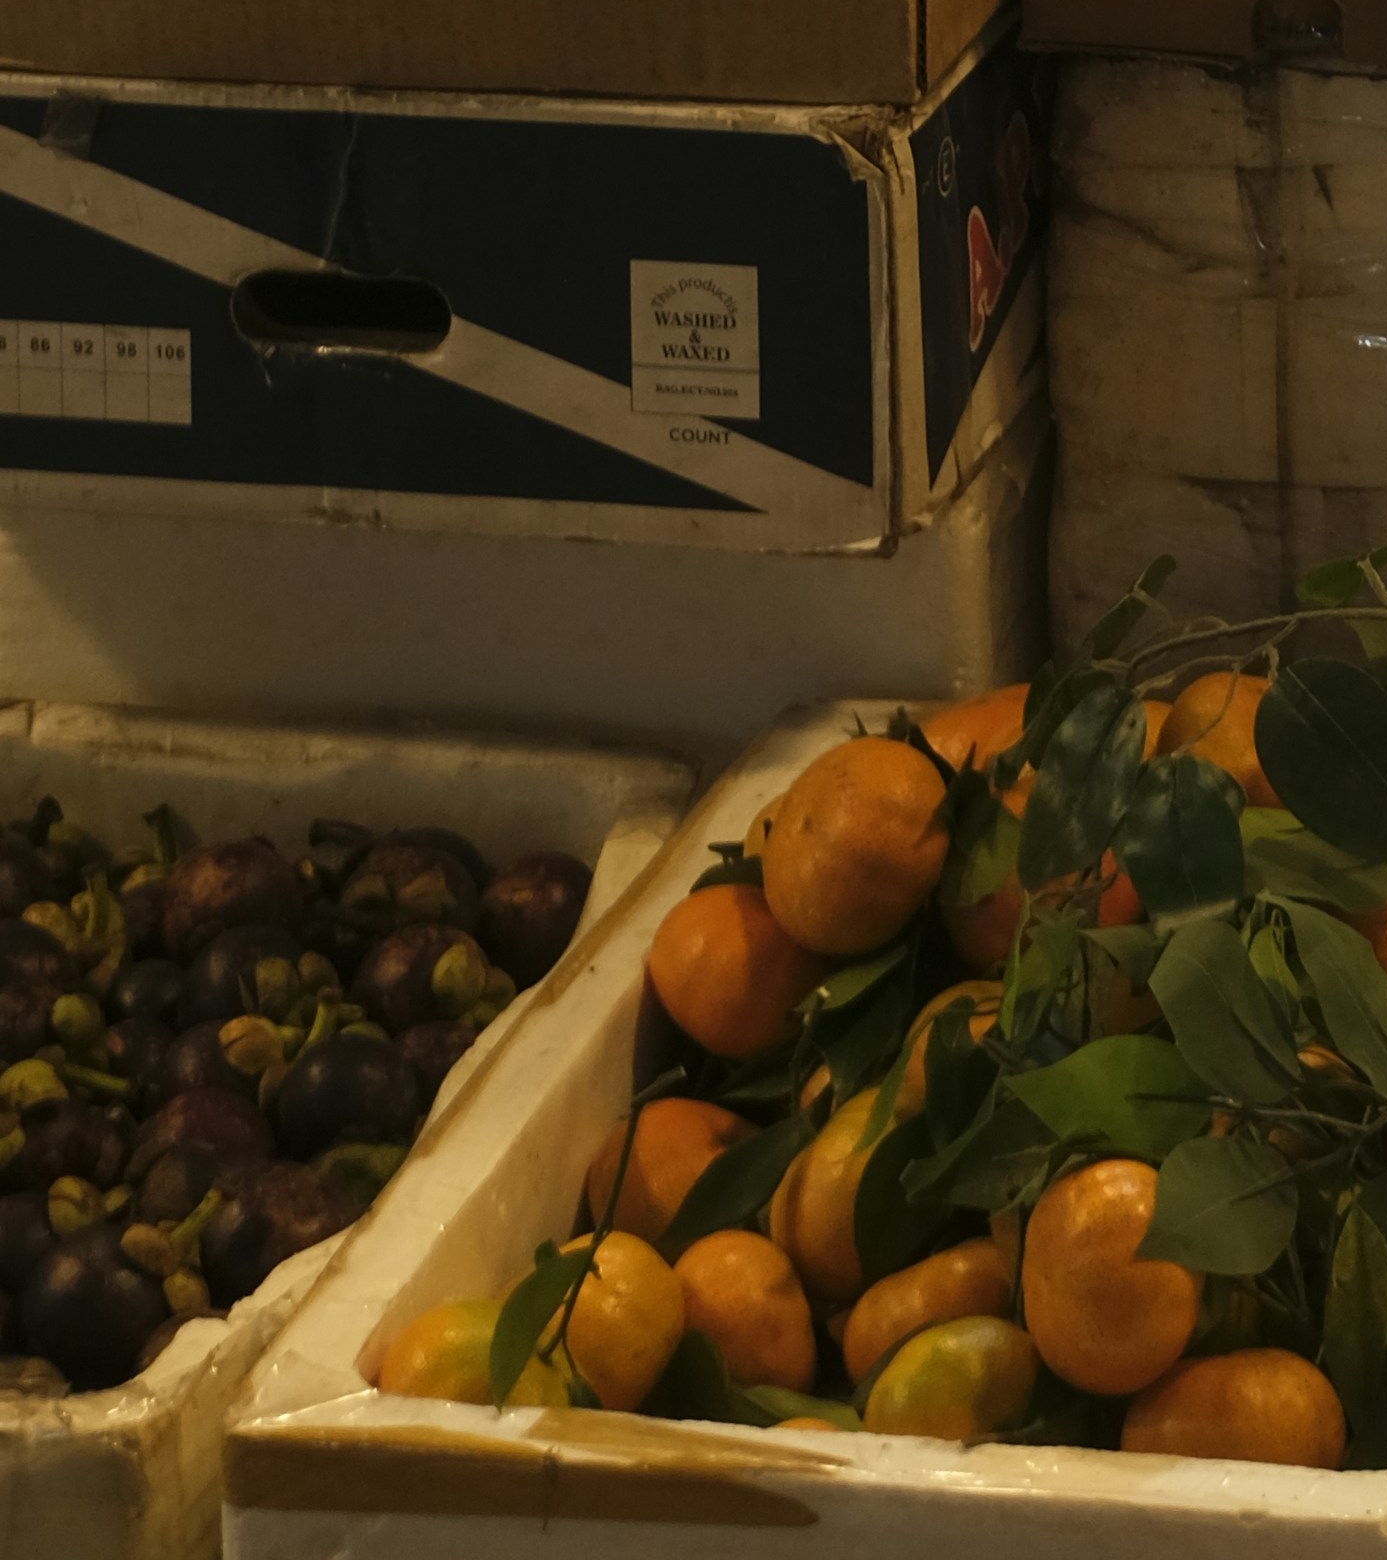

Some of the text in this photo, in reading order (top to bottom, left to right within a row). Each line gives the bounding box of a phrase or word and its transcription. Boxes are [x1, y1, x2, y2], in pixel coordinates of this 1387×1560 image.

[650, 284, 678, 309] This
[653, 309, 737, 330] WASHED
[689, 328, 702, 344] &
[73, 339, 94, 355] 92
[116, 342, 137, 358] 98
[155, 344, 186, 361] 106
[661, 343, 731, 363] WAXED
[668, 426, 732, 446] COUNT
